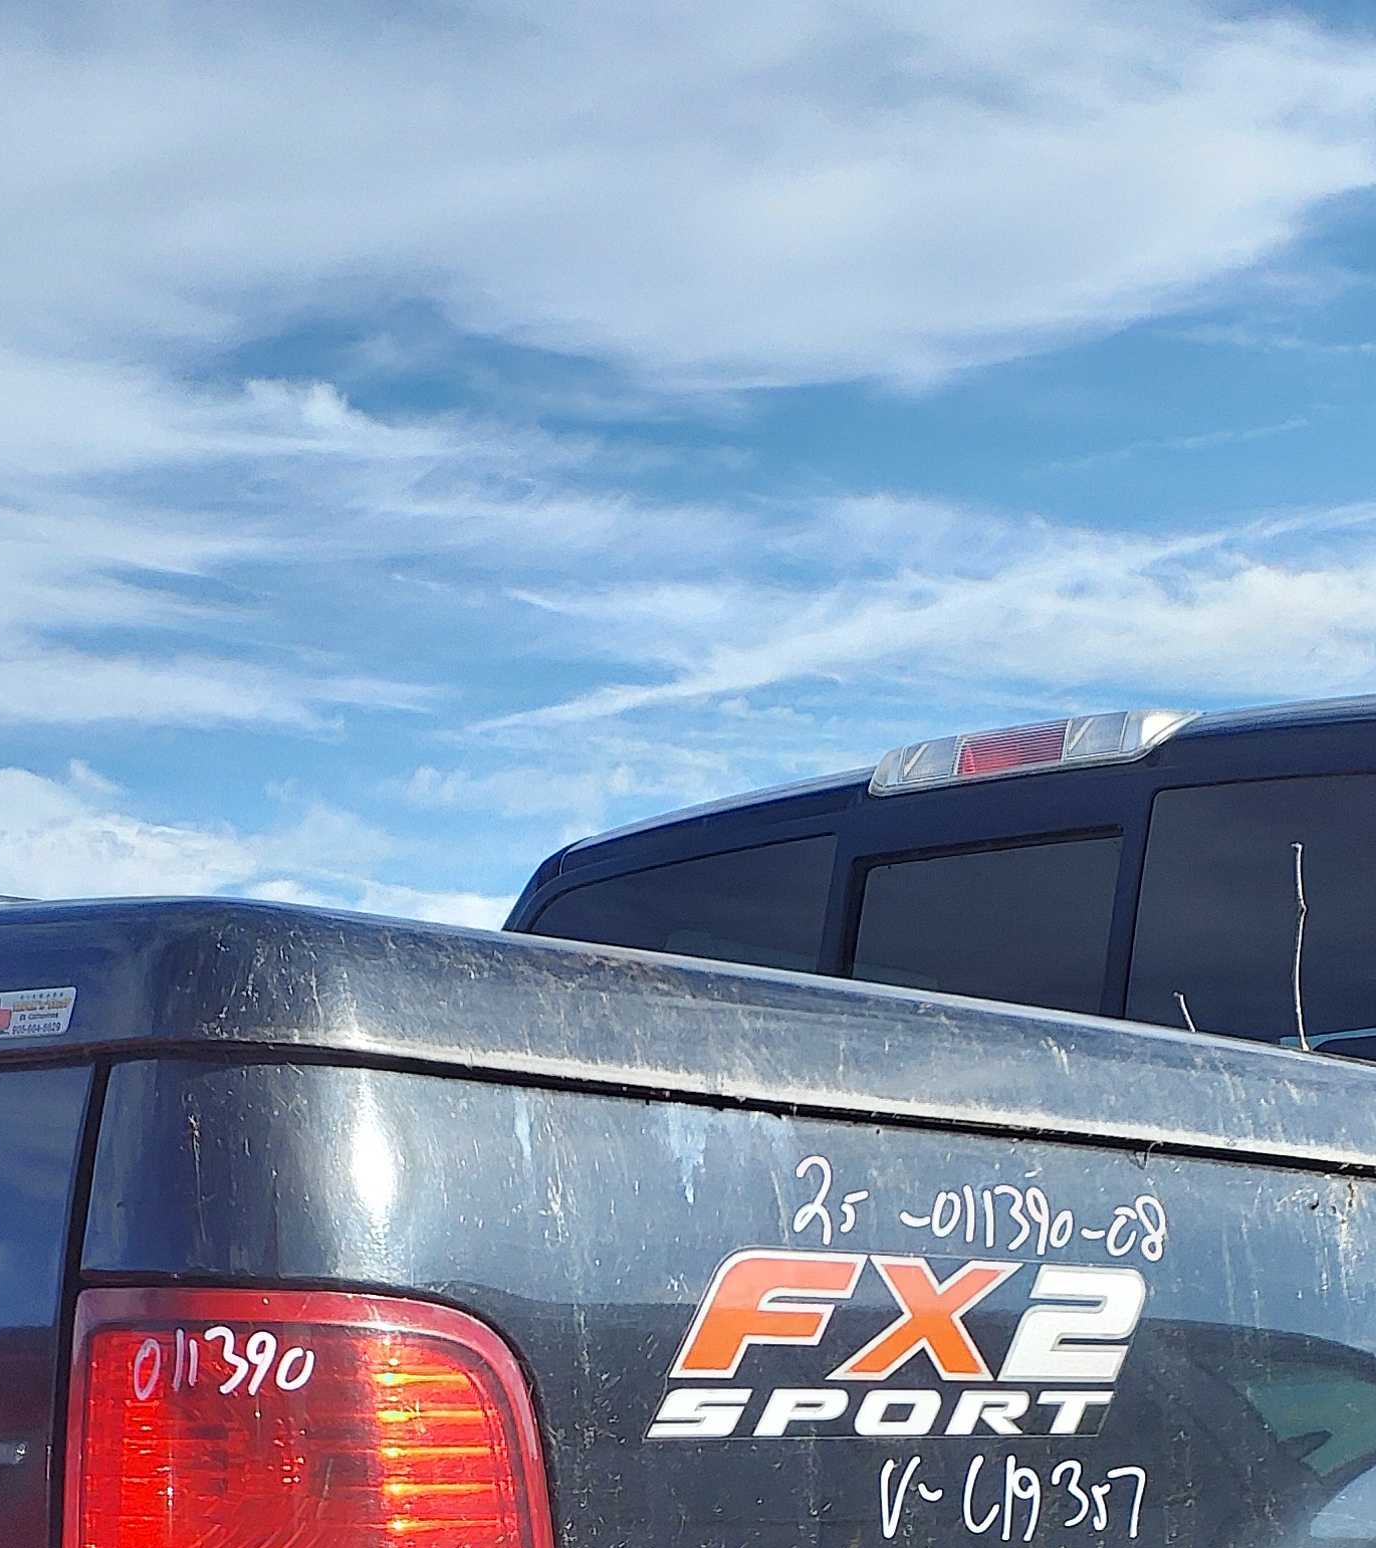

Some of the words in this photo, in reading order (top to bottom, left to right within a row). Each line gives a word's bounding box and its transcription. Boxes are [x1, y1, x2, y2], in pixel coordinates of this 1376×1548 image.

[791, 1155, 869, 1245] 25
[668, 1250, 1145, 1383] FX2
[134, 1325, 316, 1400] 011390
[646, 1388, 1115, 1437] SPORT
